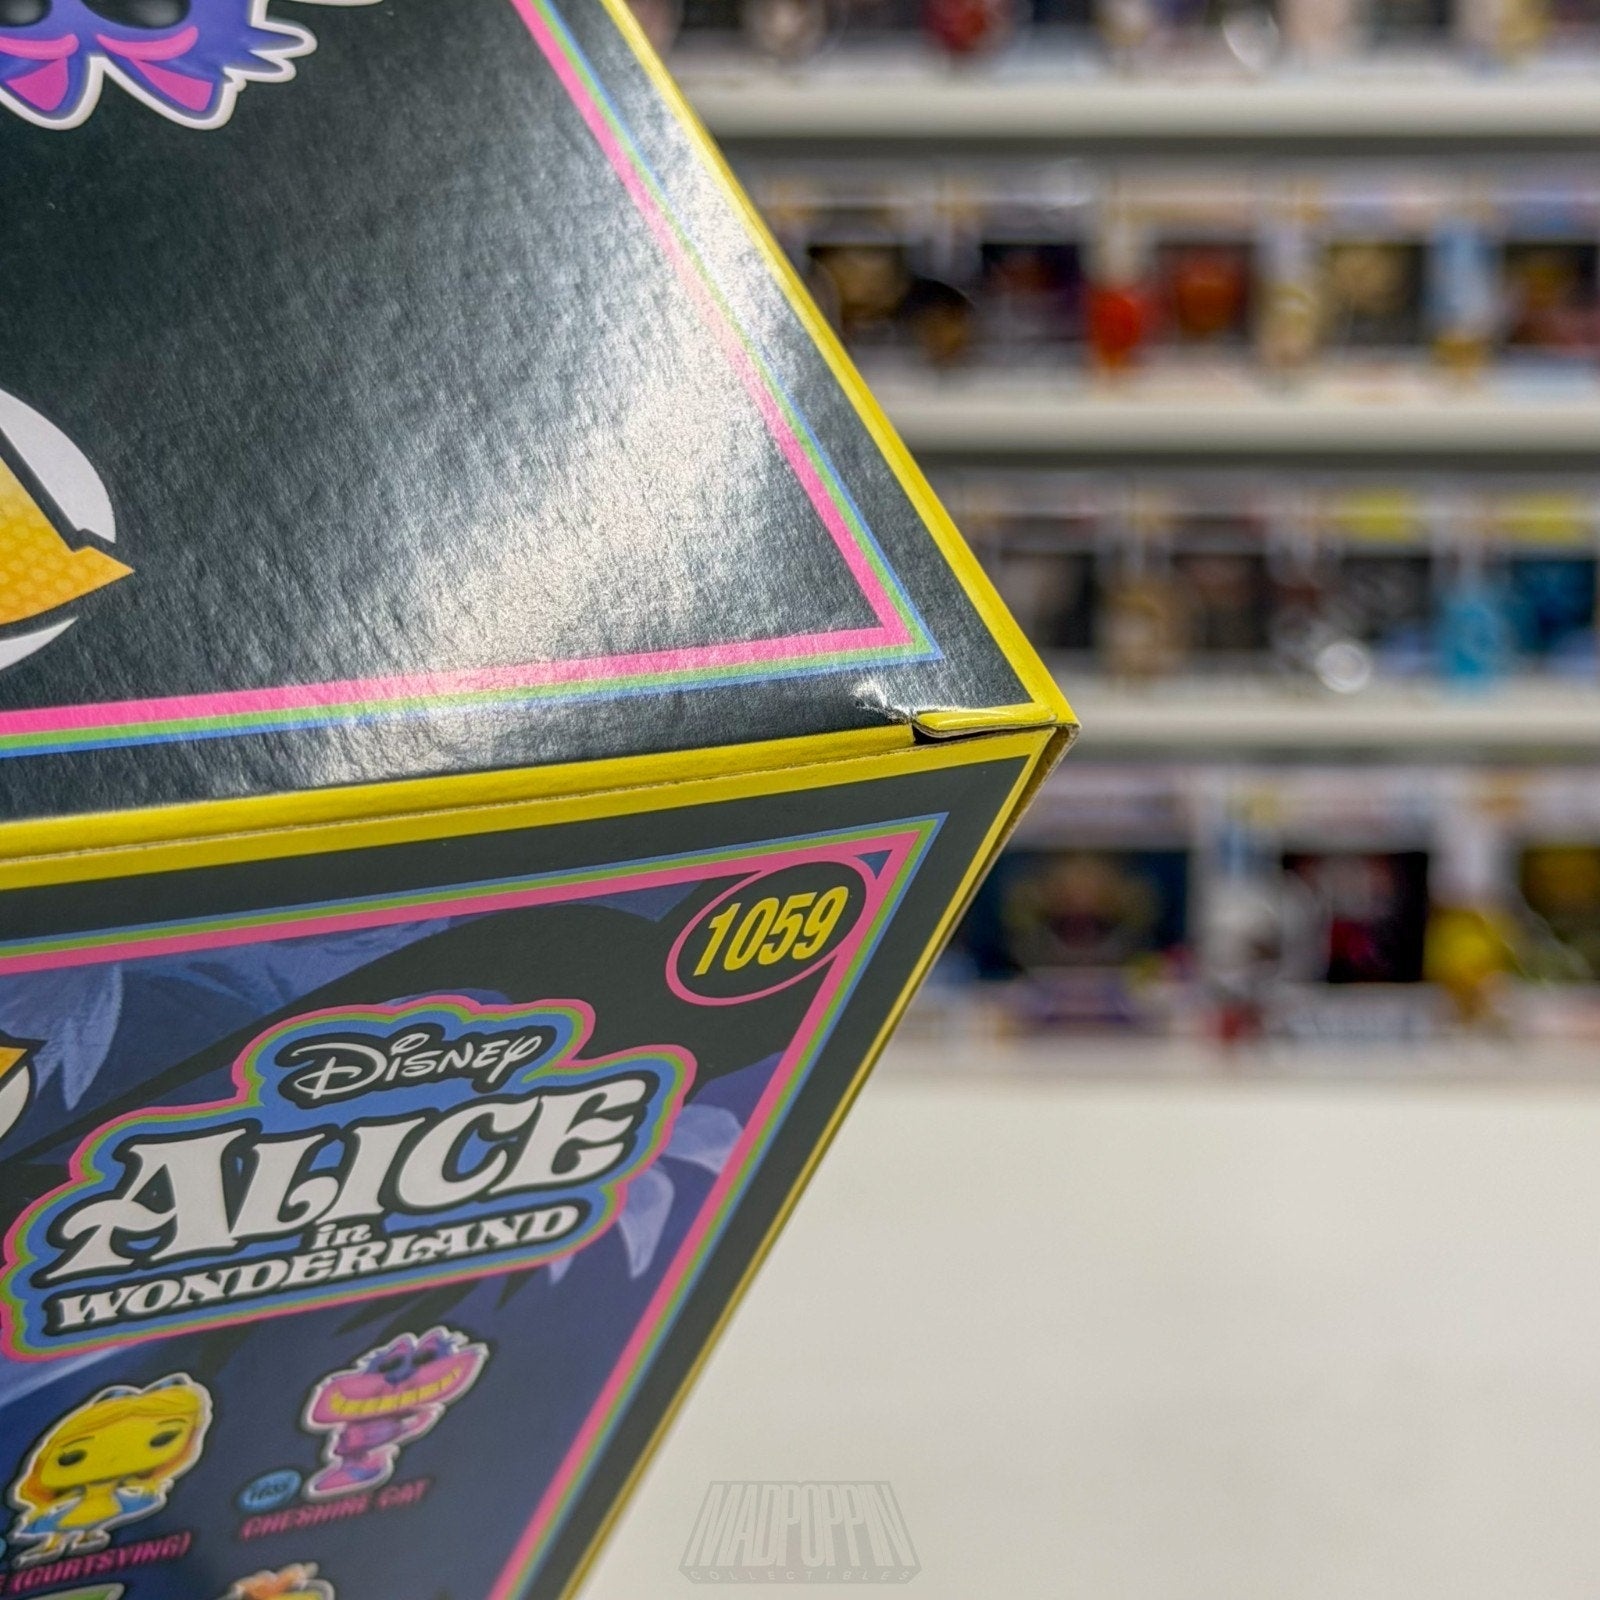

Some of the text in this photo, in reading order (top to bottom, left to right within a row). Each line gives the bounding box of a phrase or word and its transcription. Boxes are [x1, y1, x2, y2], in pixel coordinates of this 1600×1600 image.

[693, 886, 849, 976] 1059
[45, 1078, 647, 1281] ALICE
[57, 1206, 580, 1329] WONDERLAND
[313, 1220, 373, 1250] in
[13, 1531, 192, 1592] (CURTSYING)
